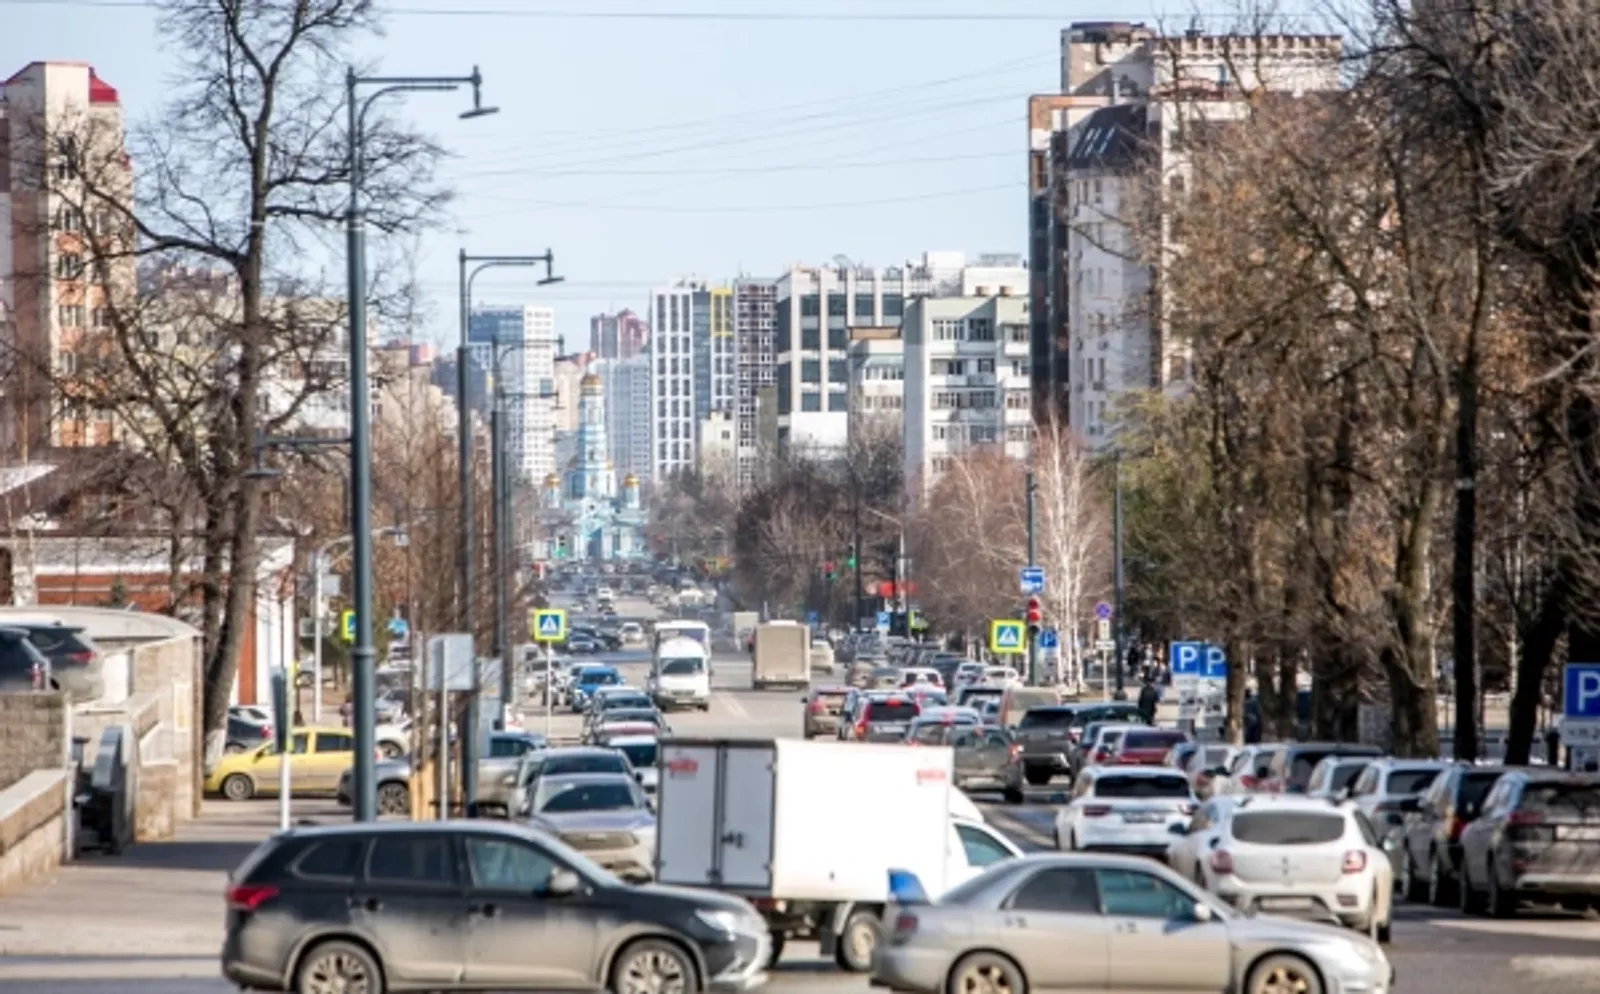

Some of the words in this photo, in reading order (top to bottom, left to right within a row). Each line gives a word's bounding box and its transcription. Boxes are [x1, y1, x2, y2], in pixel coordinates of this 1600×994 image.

[1180, 646, 1198, 671] P
[1207, 647, 1226, 674] P
[1578, 670, 1600, 712] P
